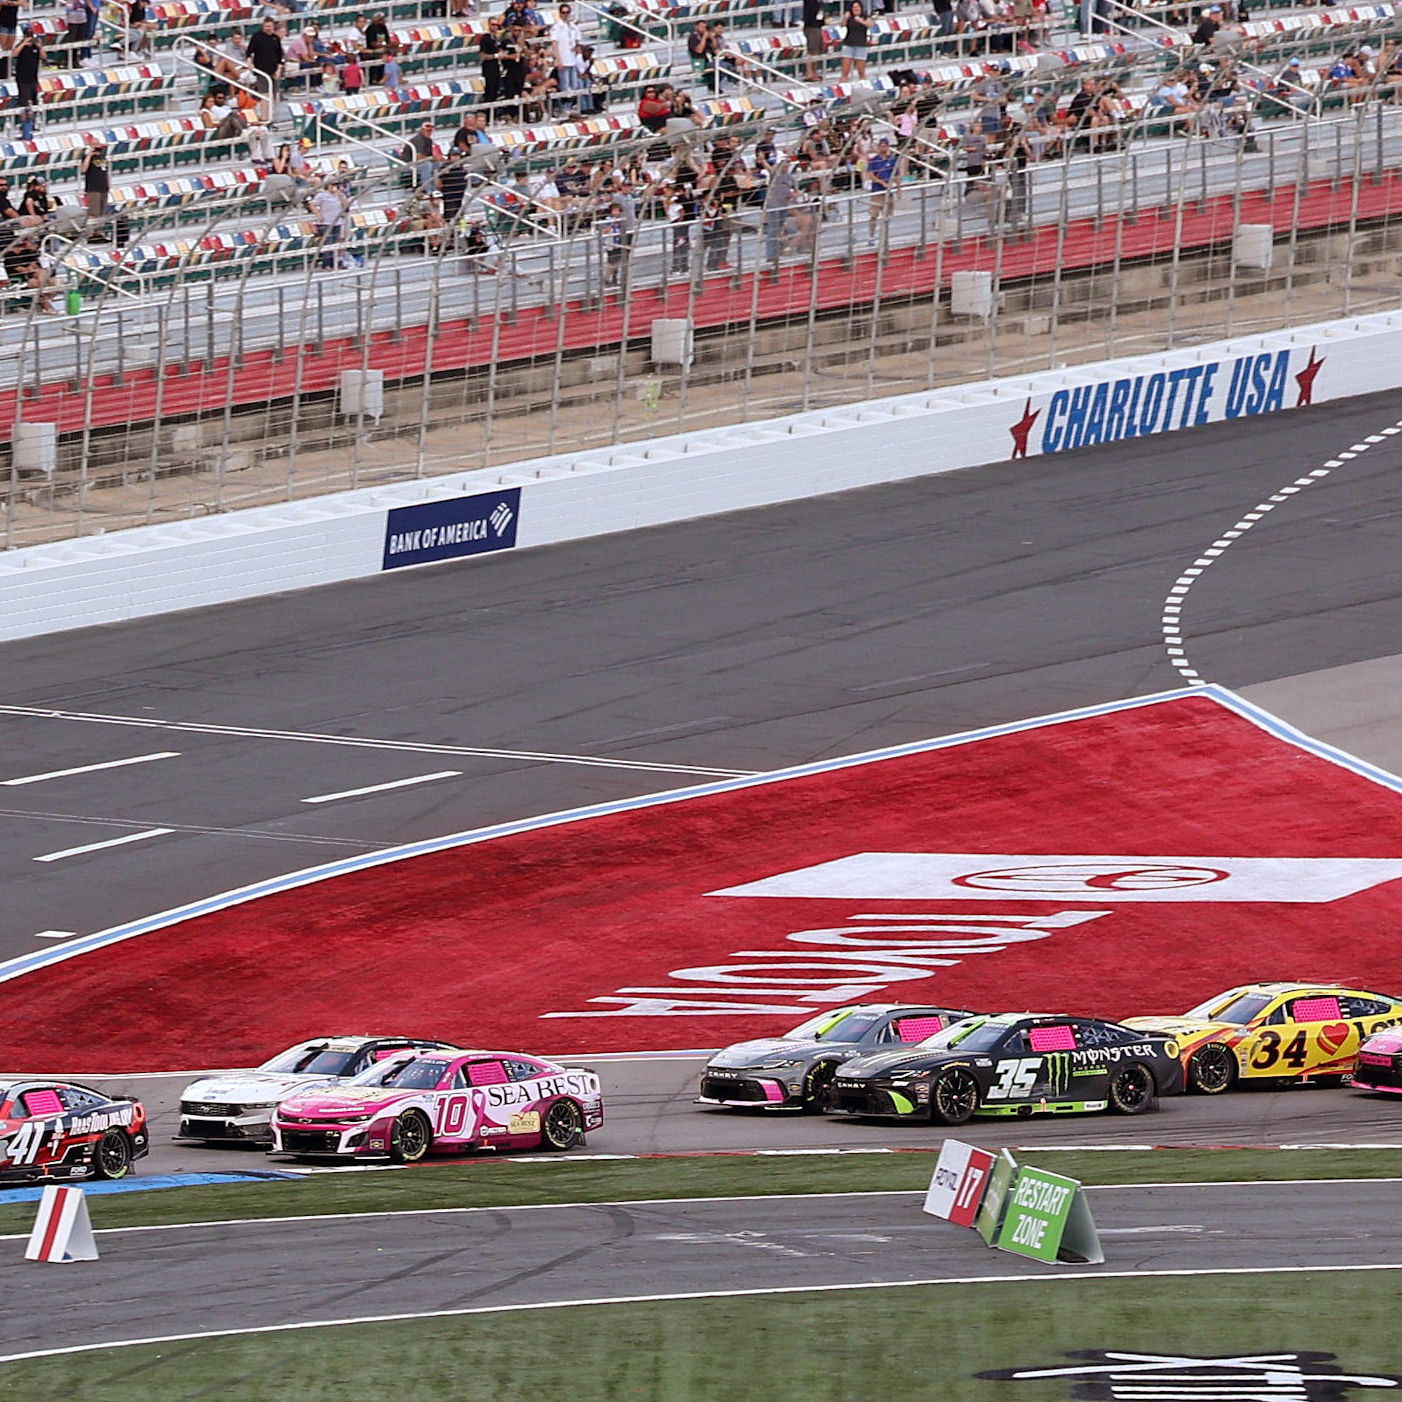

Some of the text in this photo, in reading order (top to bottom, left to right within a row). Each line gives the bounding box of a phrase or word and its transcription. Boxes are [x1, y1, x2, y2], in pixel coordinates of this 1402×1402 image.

[1042, 349, 1291, 455] CHARLOTTE USA
[389, 519, 488, 555] BANK OF AMERICA
[539, 910, 1113, 1018] TOYOTA
[1072, 1044, 1158, 1065] MONSTER
[1251, 1030, 1308, 1070] 34
[488, 1075, 591, 1107] SEA BEST
[986, 1057, 1044, 1099] 35
[434, 1092, 470, 1137] 10
[6, 1121, 46, 1166] 41
[958, 1166, 984, 1209] 17
[1014, 1176, 1071, 1216] RESTART
[1012, 1214, 1049, 1249] ZONE
